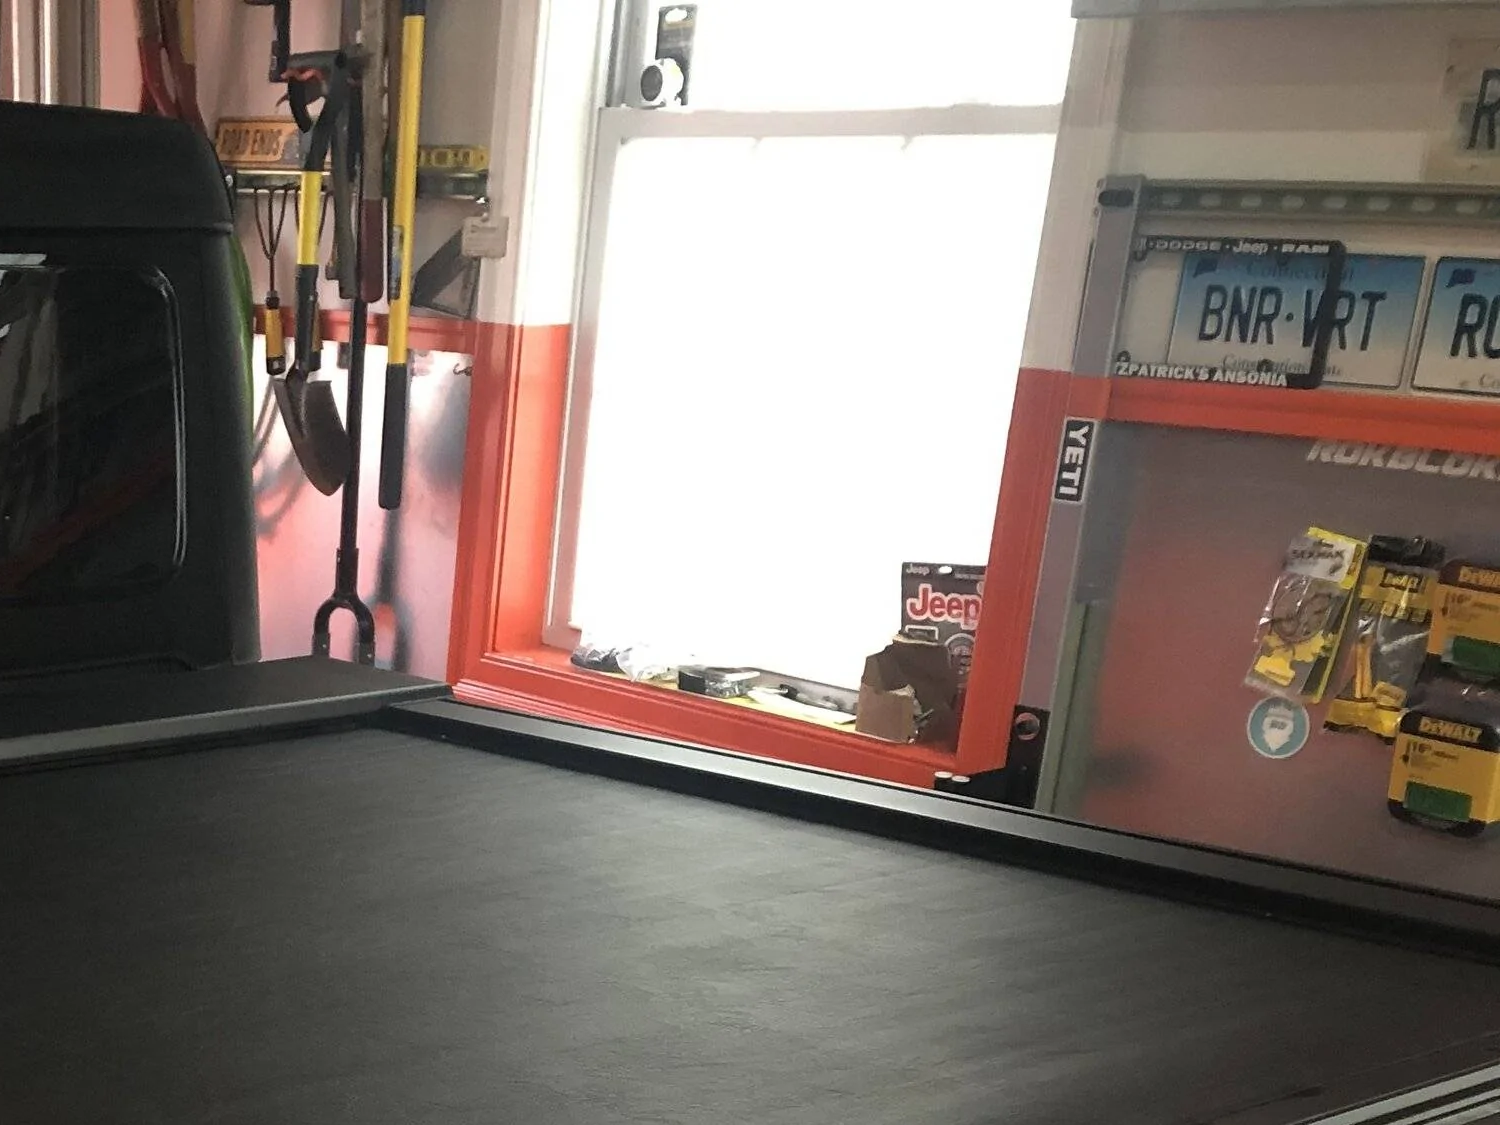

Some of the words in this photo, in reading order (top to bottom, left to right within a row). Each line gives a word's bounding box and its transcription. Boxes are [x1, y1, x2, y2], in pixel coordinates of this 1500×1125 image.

[1233, 240, 1269, 255] Jeep
[1281, 242, 1330, 254] RAM
[1213, 368, 1288, 388] ANSONIA
[1059, 425, 1090, 495] YETI
[906, 563, 930, 576] Jeep
[908, 585, 982, 629] Jeep
